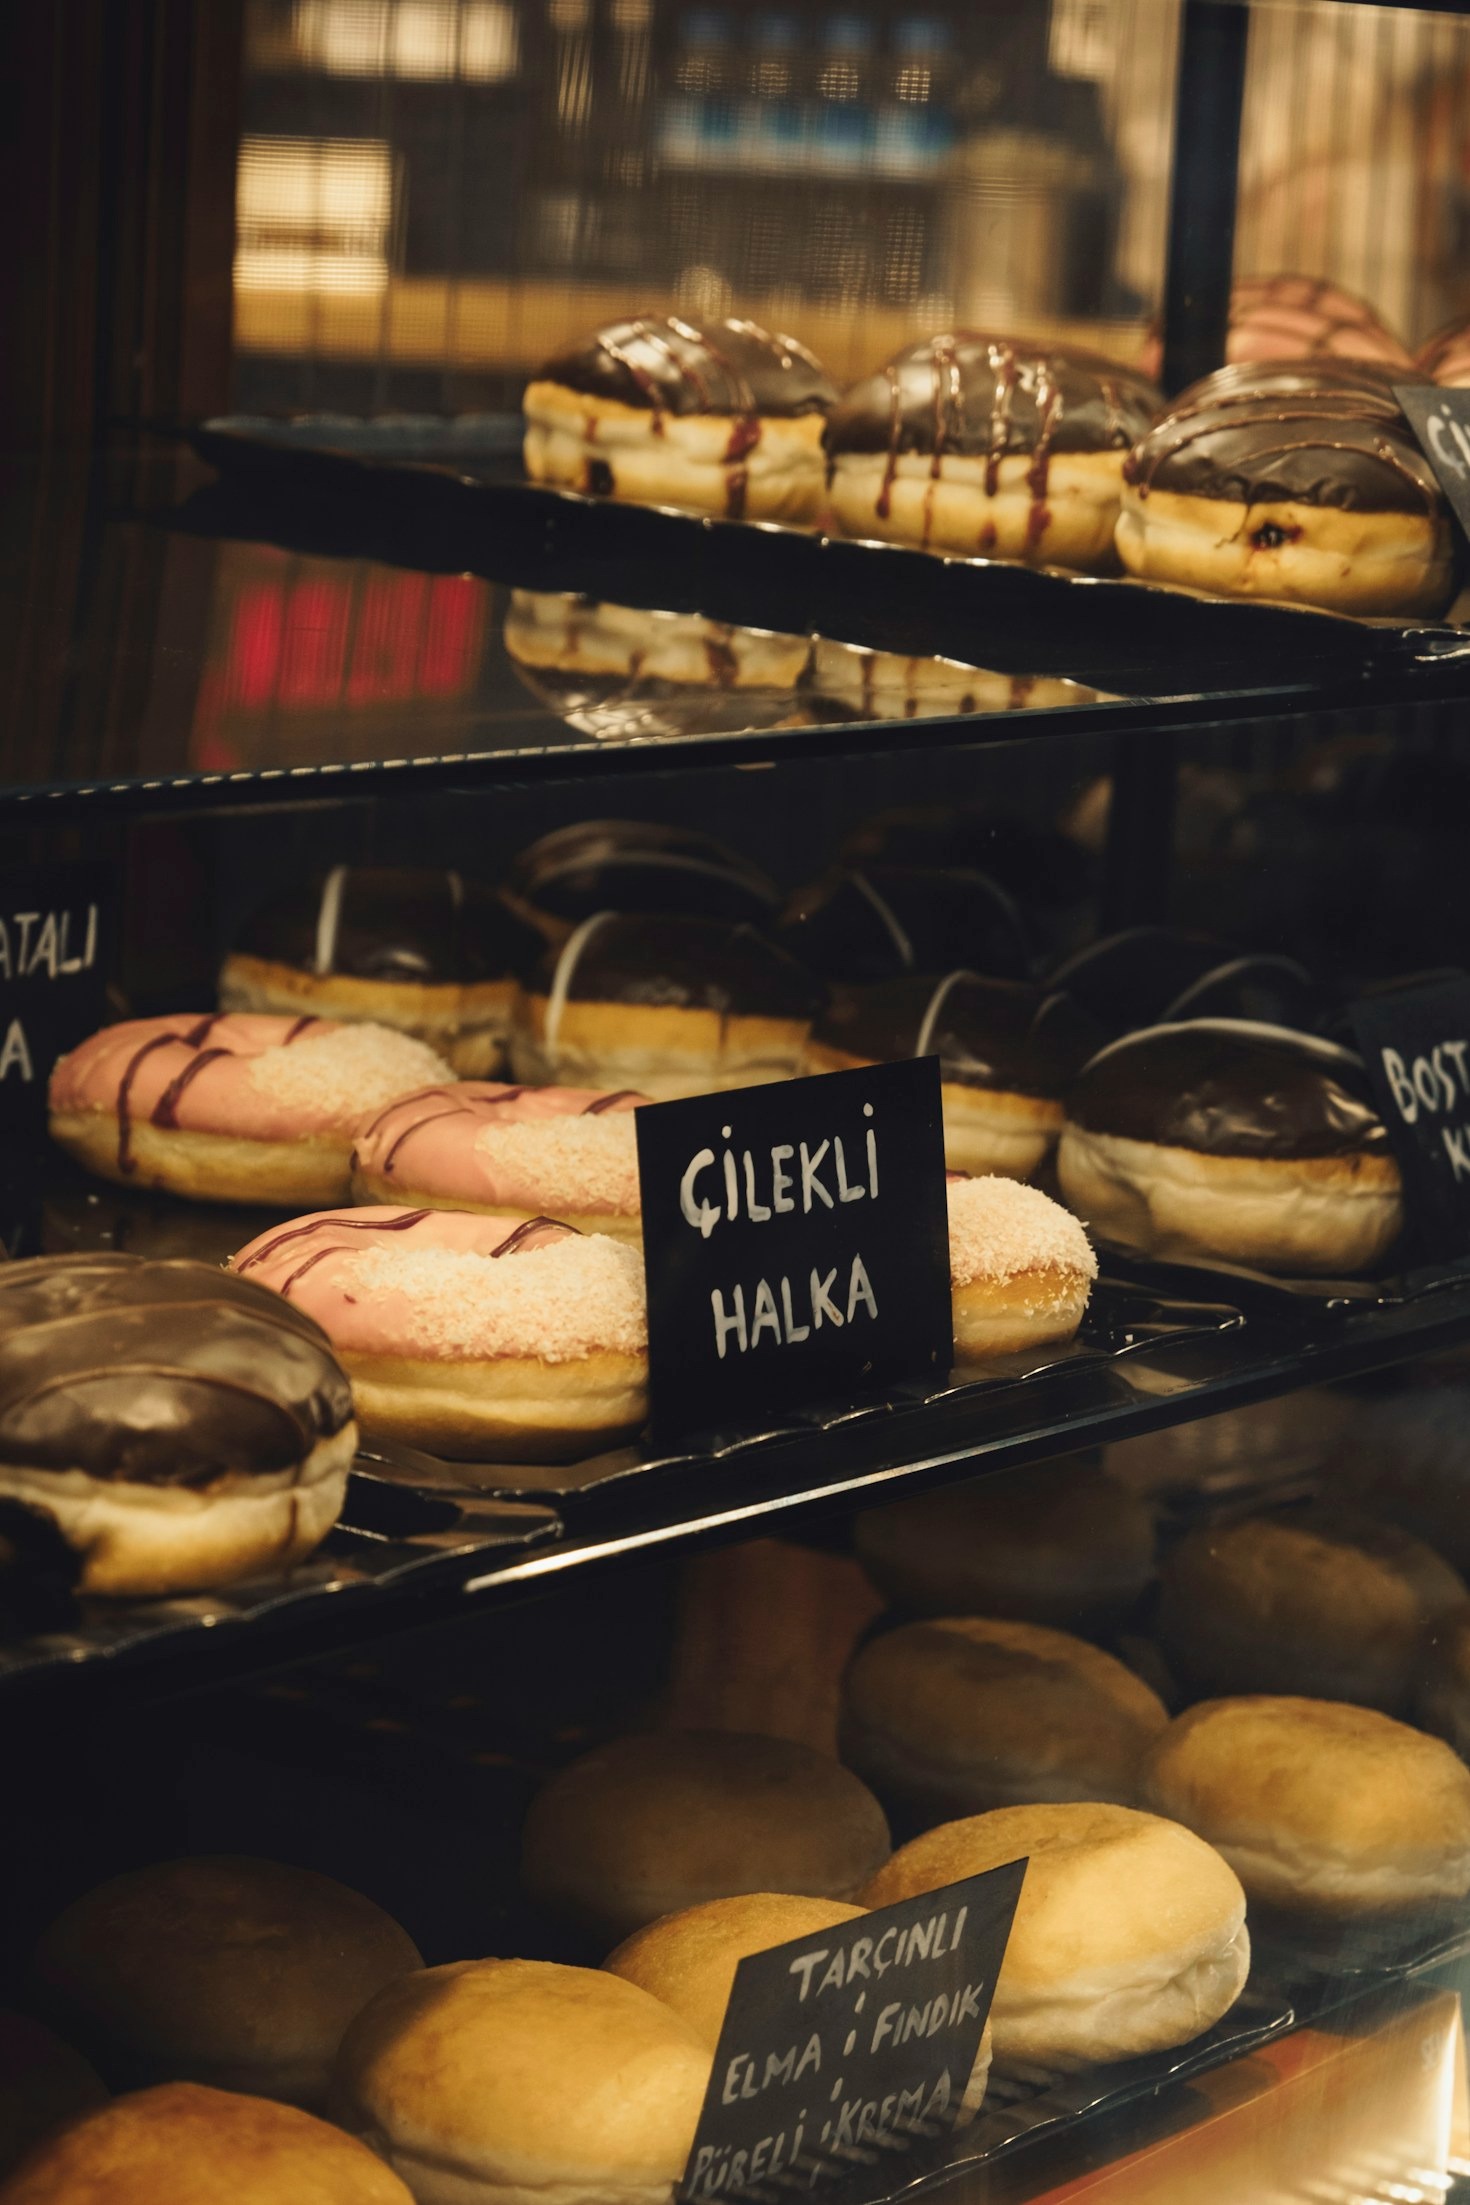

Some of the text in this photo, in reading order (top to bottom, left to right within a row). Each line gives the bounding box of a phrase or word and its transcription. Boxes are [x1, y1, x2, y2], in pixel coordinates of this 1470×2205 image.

[1427, 403, 1470, 480] Çİ
[680, 1102, 879, 1239] ÇİLEKLİ
[711, 1253, 878, 1359] HALKA
[870, 1982, 984, 2054] FINDIK
[722, 2033, 822, 2106] ELMA
[830, 2066, 951, 2154] KREMA
